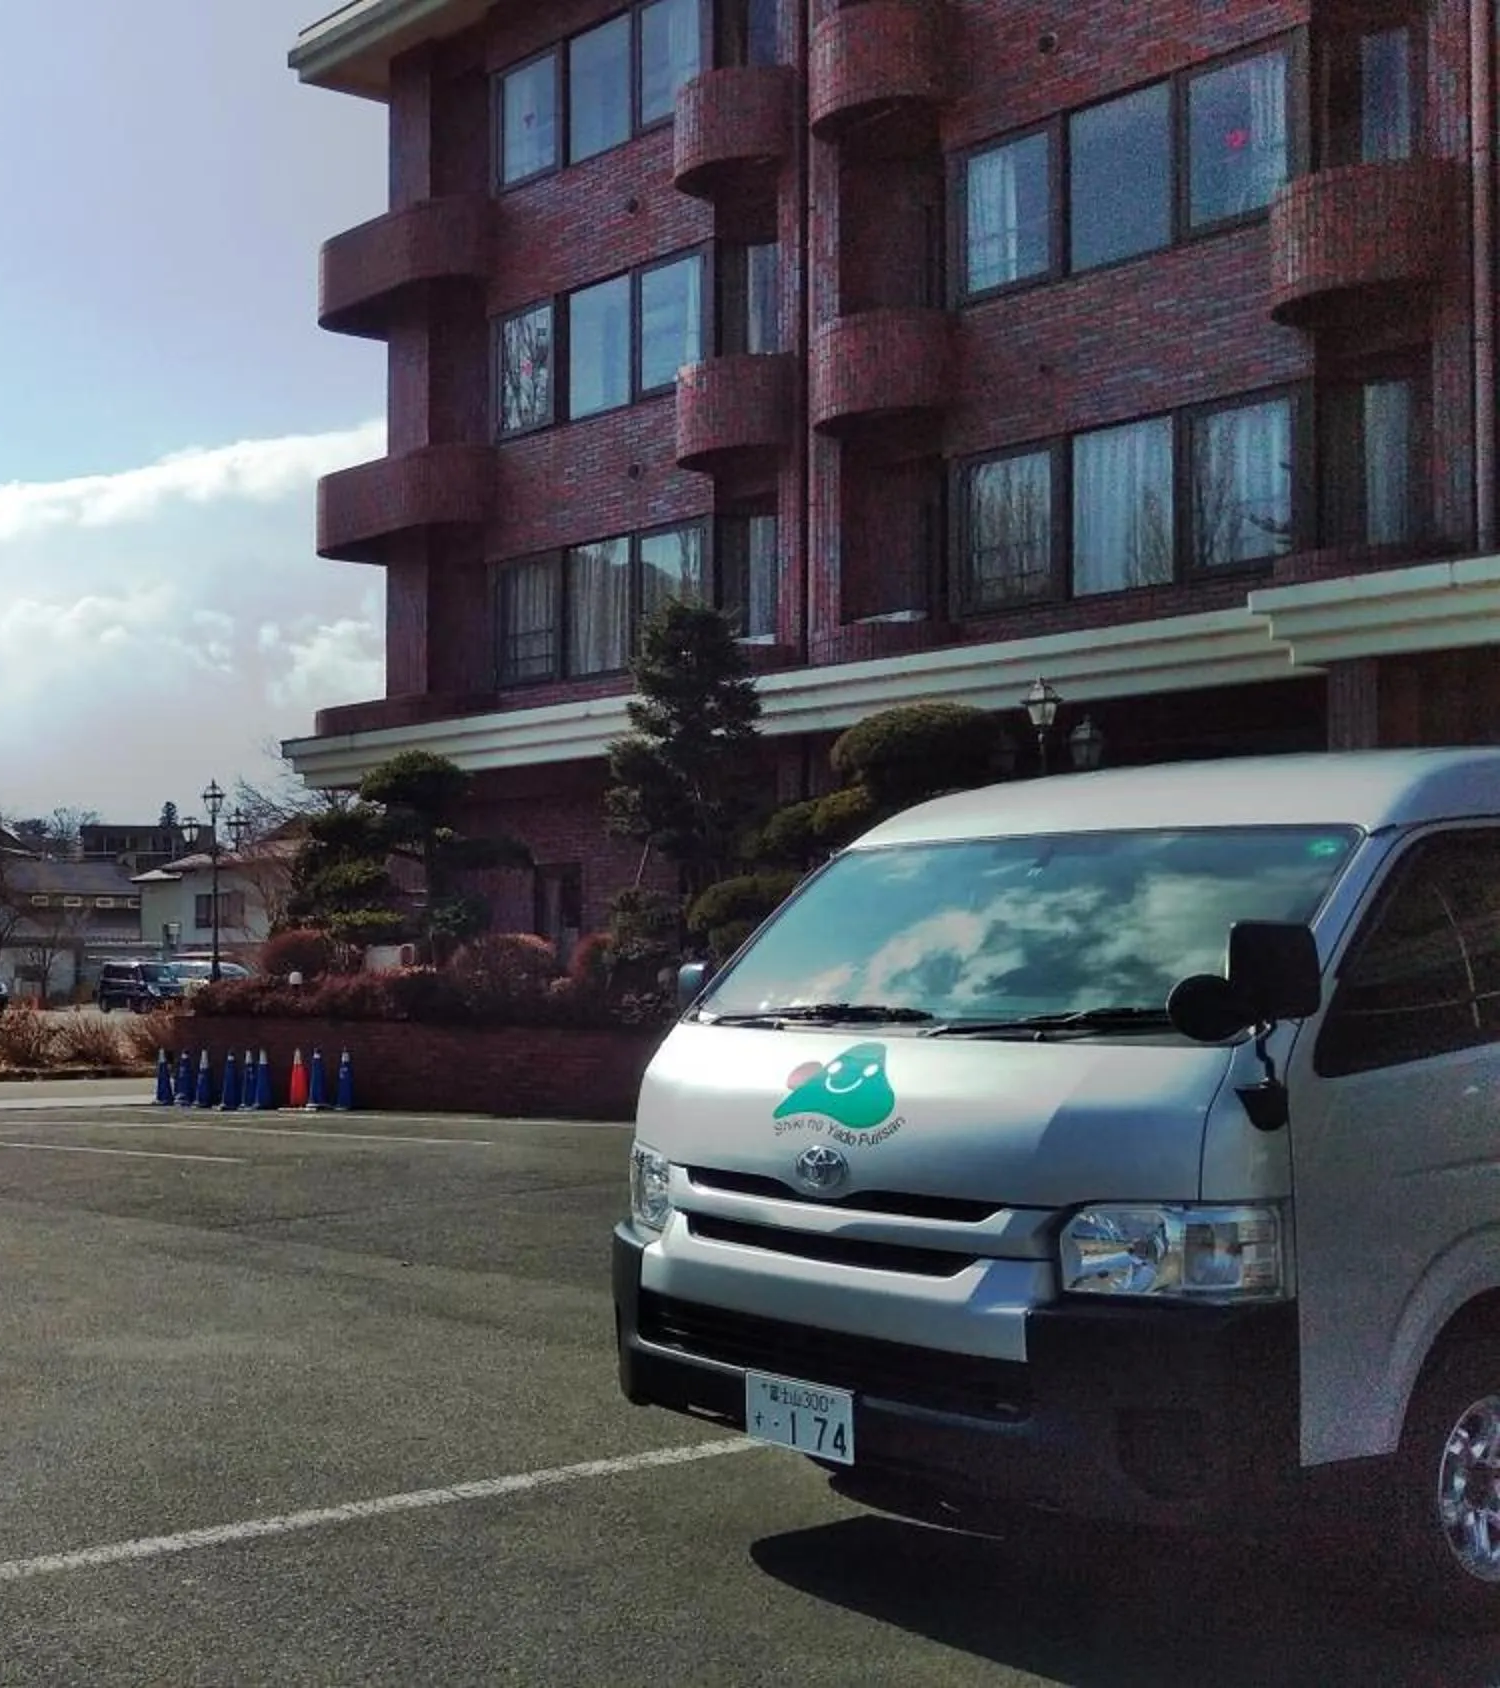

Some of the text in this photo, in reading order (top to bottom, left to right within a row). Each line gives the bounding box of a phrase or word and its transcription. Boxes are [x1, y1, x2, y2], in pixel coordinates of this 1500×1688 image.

[773, 1116, 906, 1147] Shiki no Yado Fujisan
